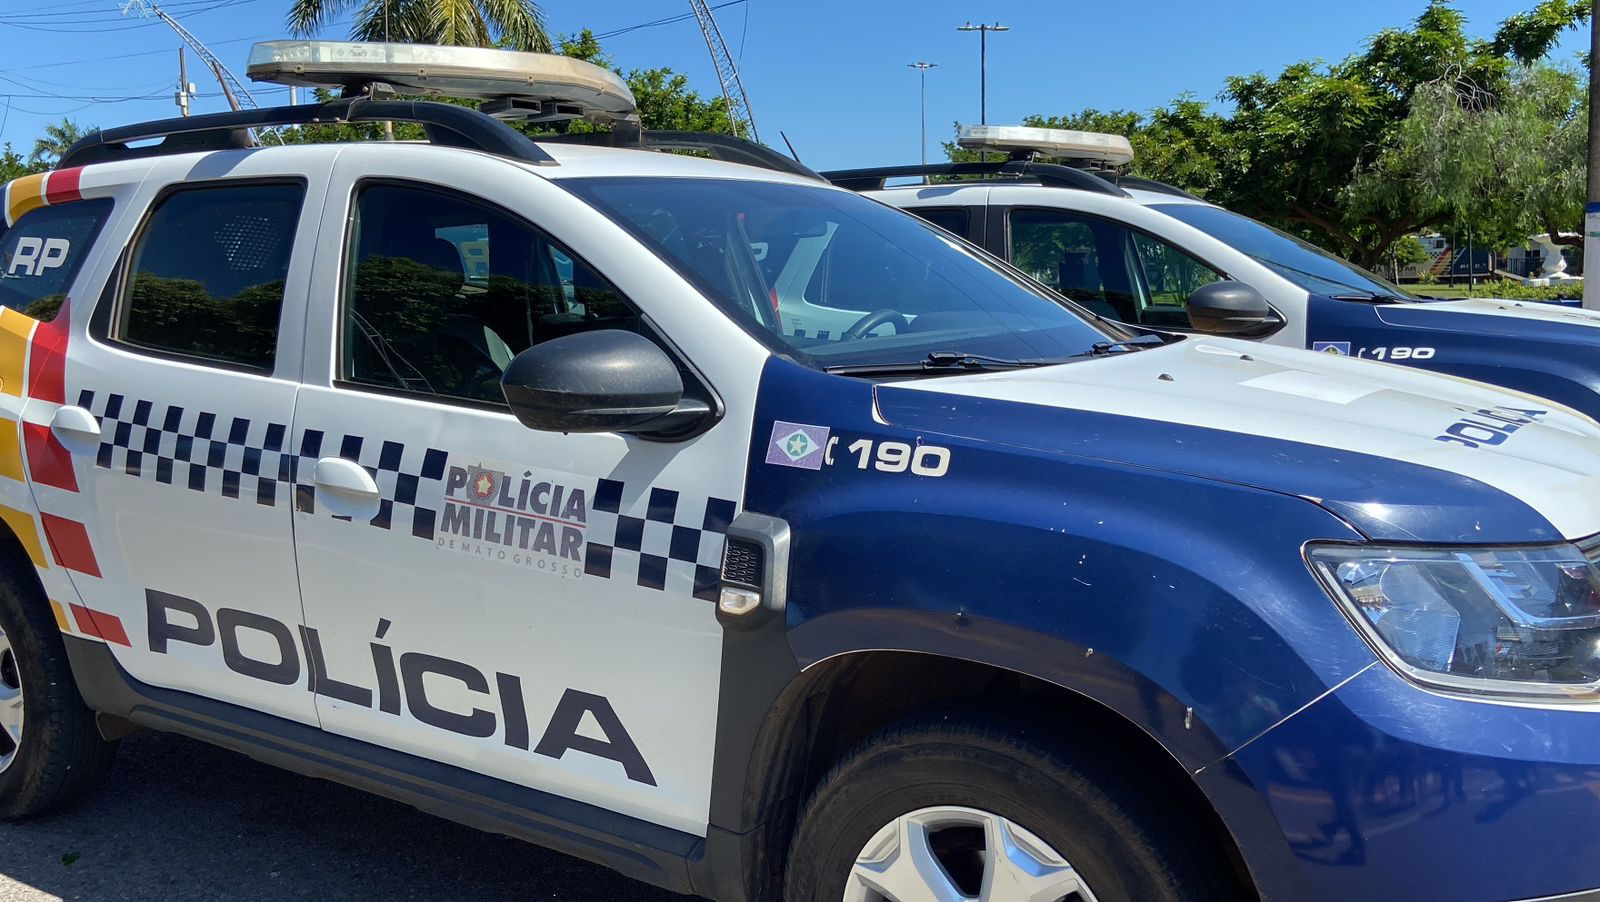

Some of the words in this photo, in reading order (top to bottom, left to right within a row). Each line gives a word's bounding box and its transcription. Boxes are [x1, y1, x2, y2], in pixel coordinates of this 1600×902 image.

[8, 236, 70, 276] RP
[1371, 347, 1435, 360] 190
[848, 439, 950, 477] 190
[441, 503, 584, 562] MILITAR
[438, 537, 455, 549] DE
[461, 543, 505, 560] MATO
[513, 554, 582, 578] GROSSO
[145, 588, 657, 787] POLÍCIA
